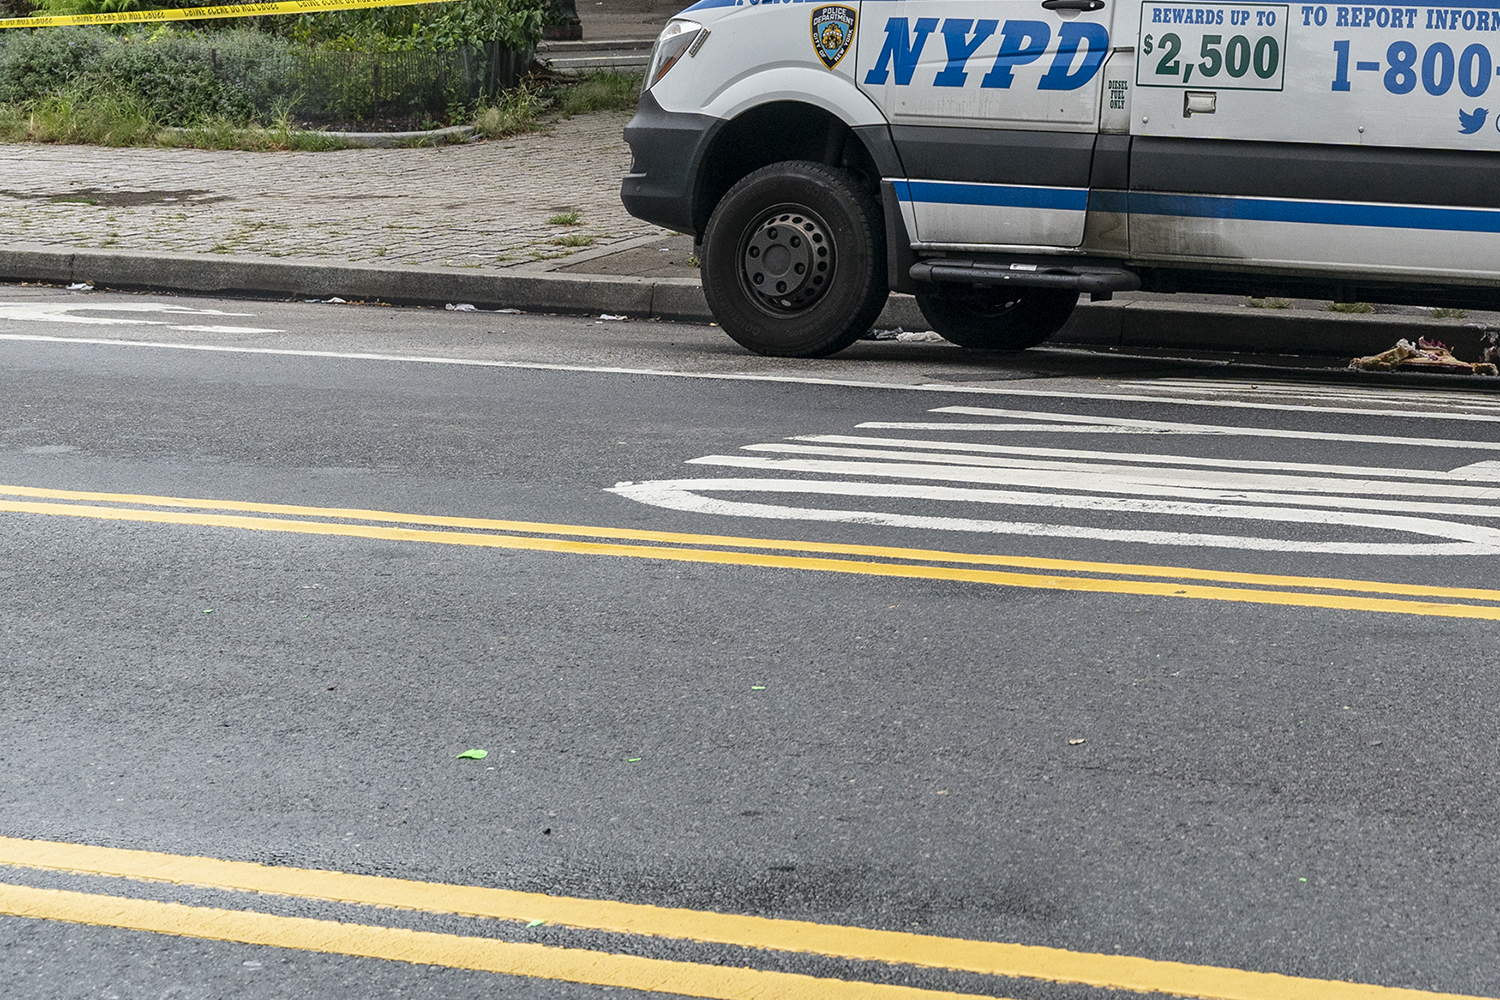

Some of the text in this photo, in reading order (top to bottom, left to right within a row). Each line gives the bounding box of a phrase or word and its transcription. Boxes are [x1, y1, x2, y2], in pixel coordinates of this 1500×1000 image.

[822, 7, 847, 15] POLICE
[1152, 8, 1276, 27] REWARDS UP TO
[1301, 5, 1327, 27] TO
[1336, 6, 1418, 29] REPORT
[813, 13, 854, 26] DEPARTMENT
[813, 29, 854, 61] CITY OF NEW YORK
[864, 17, 1110, 91] NYPD
[1143, 32, 1280, 84] $2,500
[1108, 80, 1128, 90] DIESEL
[1110, 90, 1125, 99] FUEL
[1110, 100, 1125, 109] ONLY
